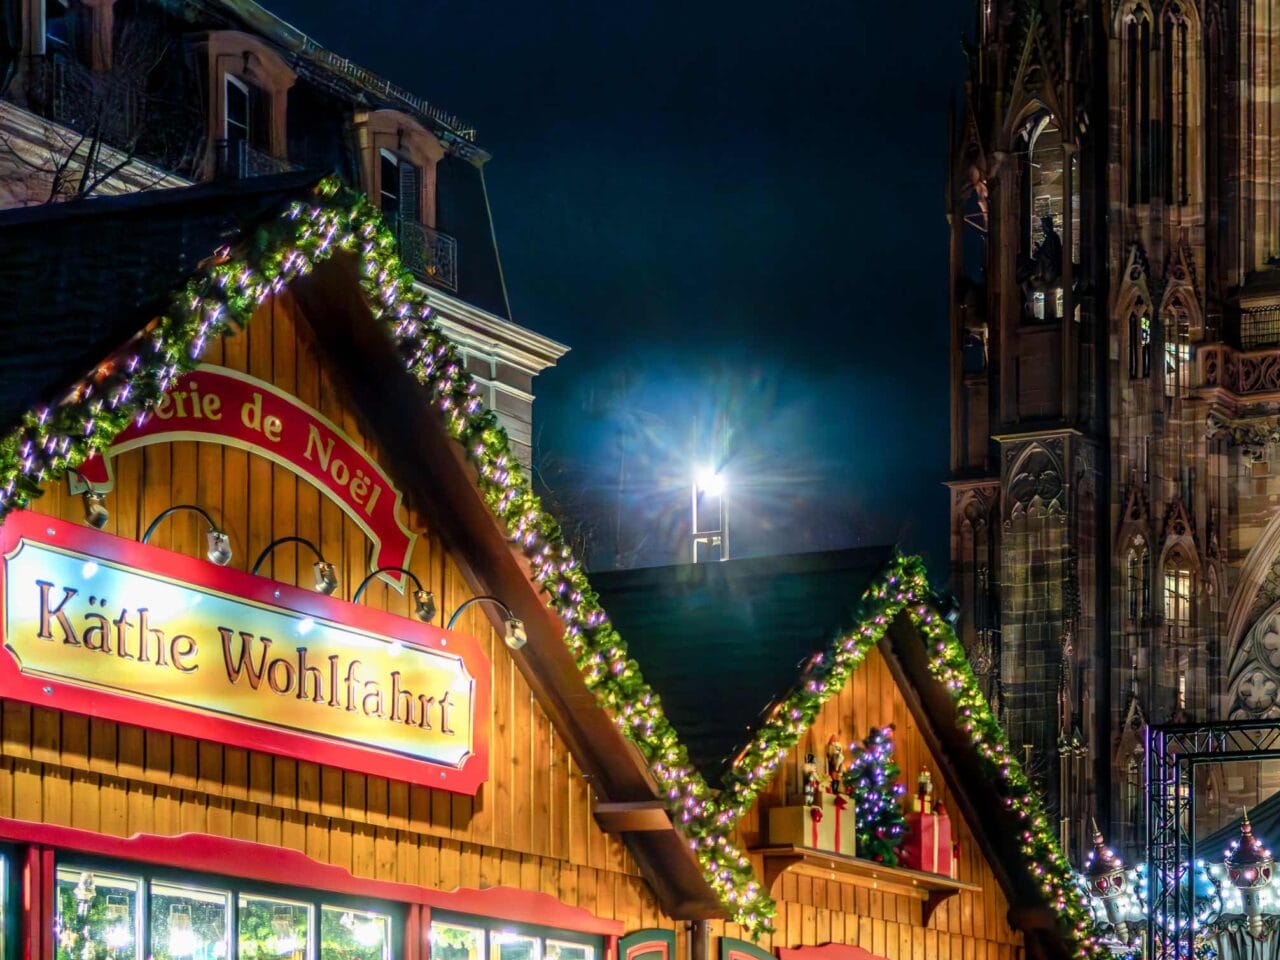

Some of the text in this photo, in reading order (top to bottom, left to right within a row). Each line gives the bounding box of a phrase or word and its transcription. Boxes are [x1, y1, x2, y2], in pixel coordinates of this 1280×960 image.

[153, 381, 382, 517] erie de Noël
[35, 579, 456, 737] Käthe Wohlfahrt
